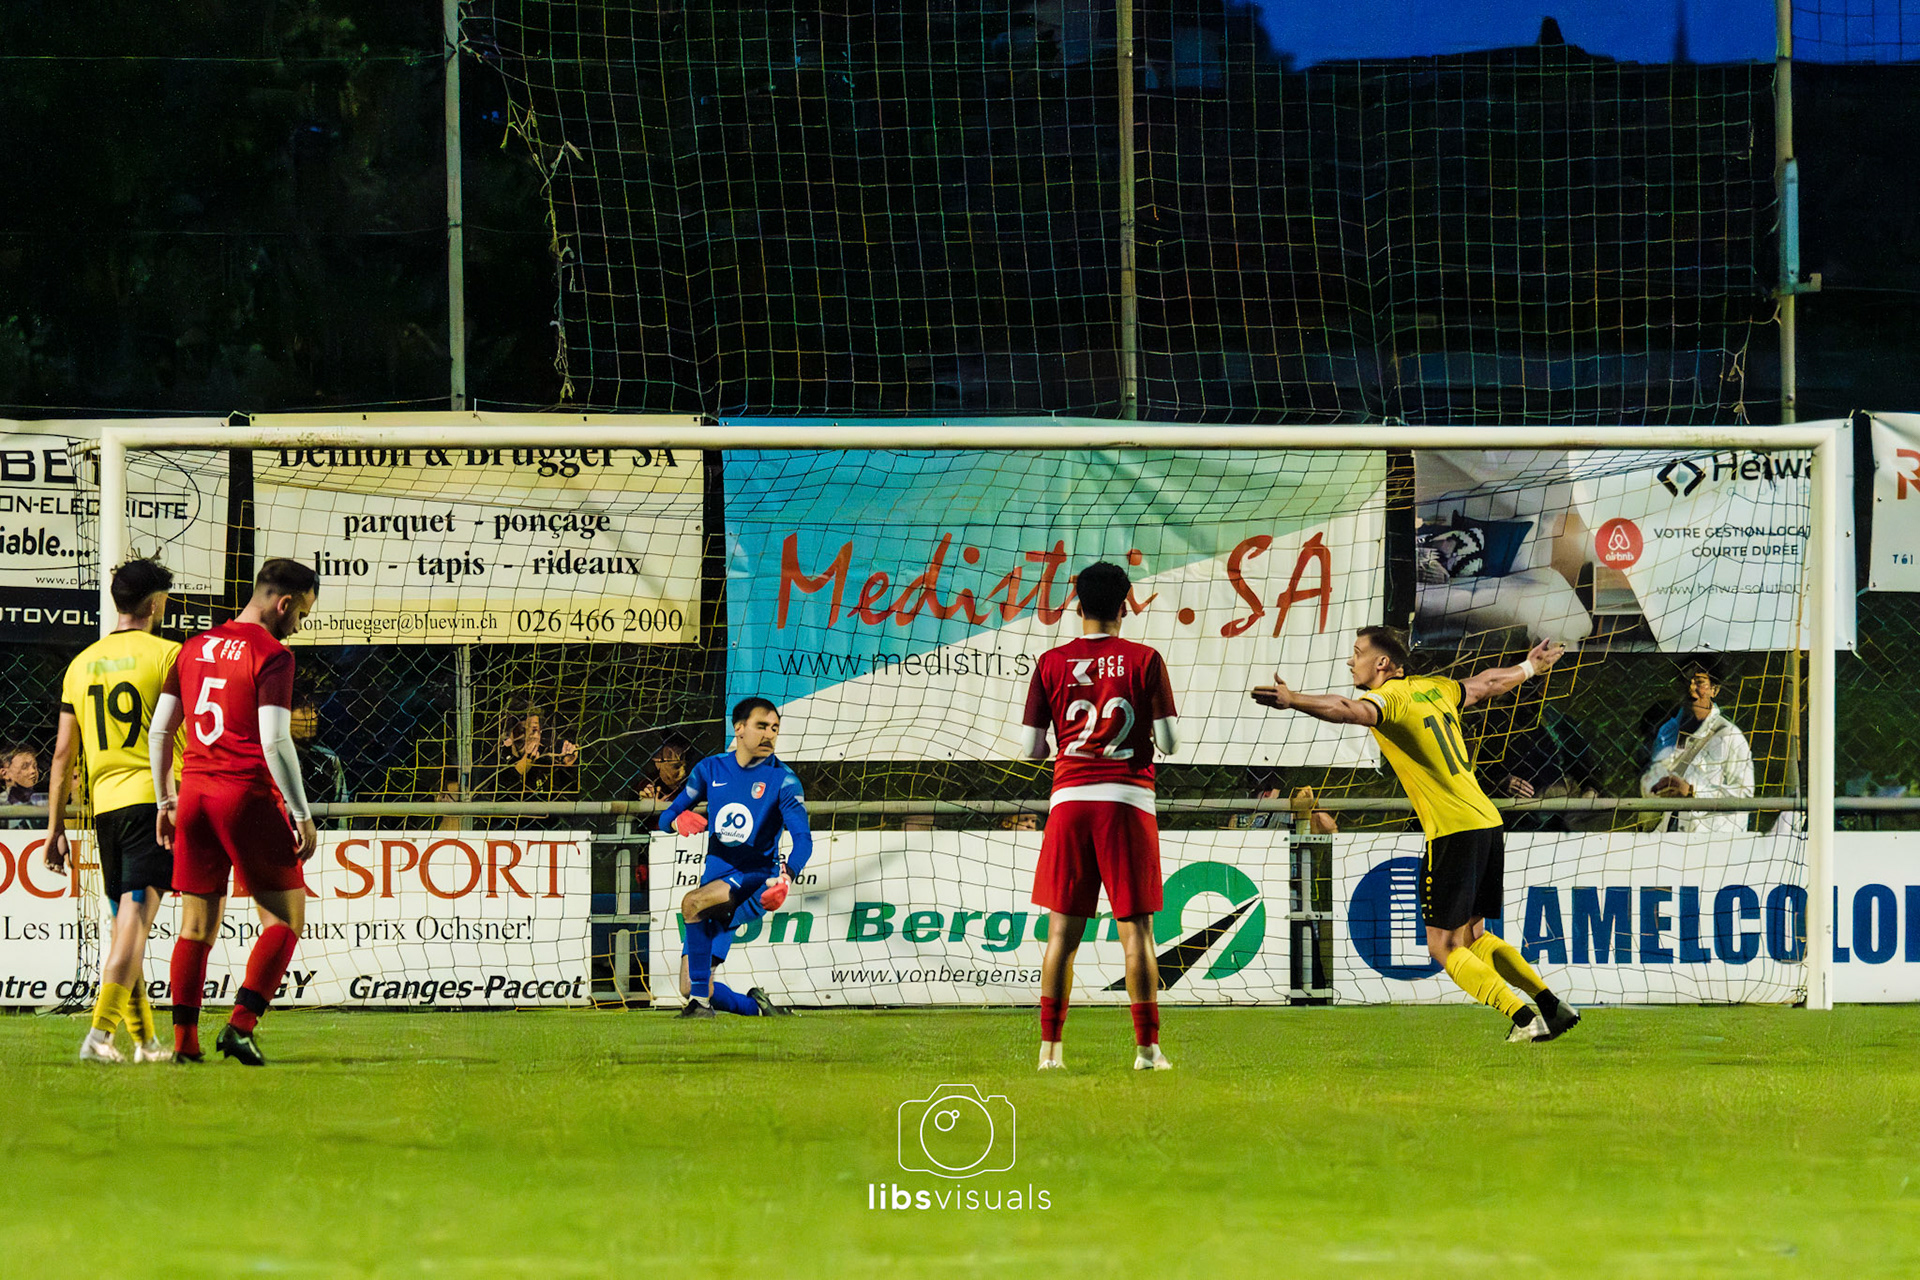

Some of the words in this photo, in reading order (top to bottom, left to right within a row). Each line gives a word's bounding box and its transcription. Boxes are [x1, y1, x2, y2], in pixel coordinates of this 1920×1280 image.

[343, 511, 456, 540] parquet
[494, 512, 611, 540] ponçage
[1654, 528, 1700, 538] VOTRE
[1705, 526, 1764, 539] GESTION
[314, 550, 369, 576] lino
[418, 550, 485, 583] tapis
[532, 550, 641, 576] rideaux
[1692, 546, 1747, 558] COURTE
[1752, 543, 1799, 556] DURÉE
[776, 532, 1159, 630] Medisti
[517, 609, 562, 632] 026
[570, 609, 615, 632] 466
[623, 609, 683, 632] 2000
[778, 645, 1040, 676] www.medistri.s
[87, 681, 142, 750] 19
[194, 677, 227, 746] 5
[1063, 697, 1135, 760] 22
[334, 838, 581, 899] SPORT
[4, 915, 50, 941] Les
[356, 919, 406, 947] prix
[416, 915, 533, 940] Ochsner!
[349, 975, 583, 1005] Granges-Paccot
